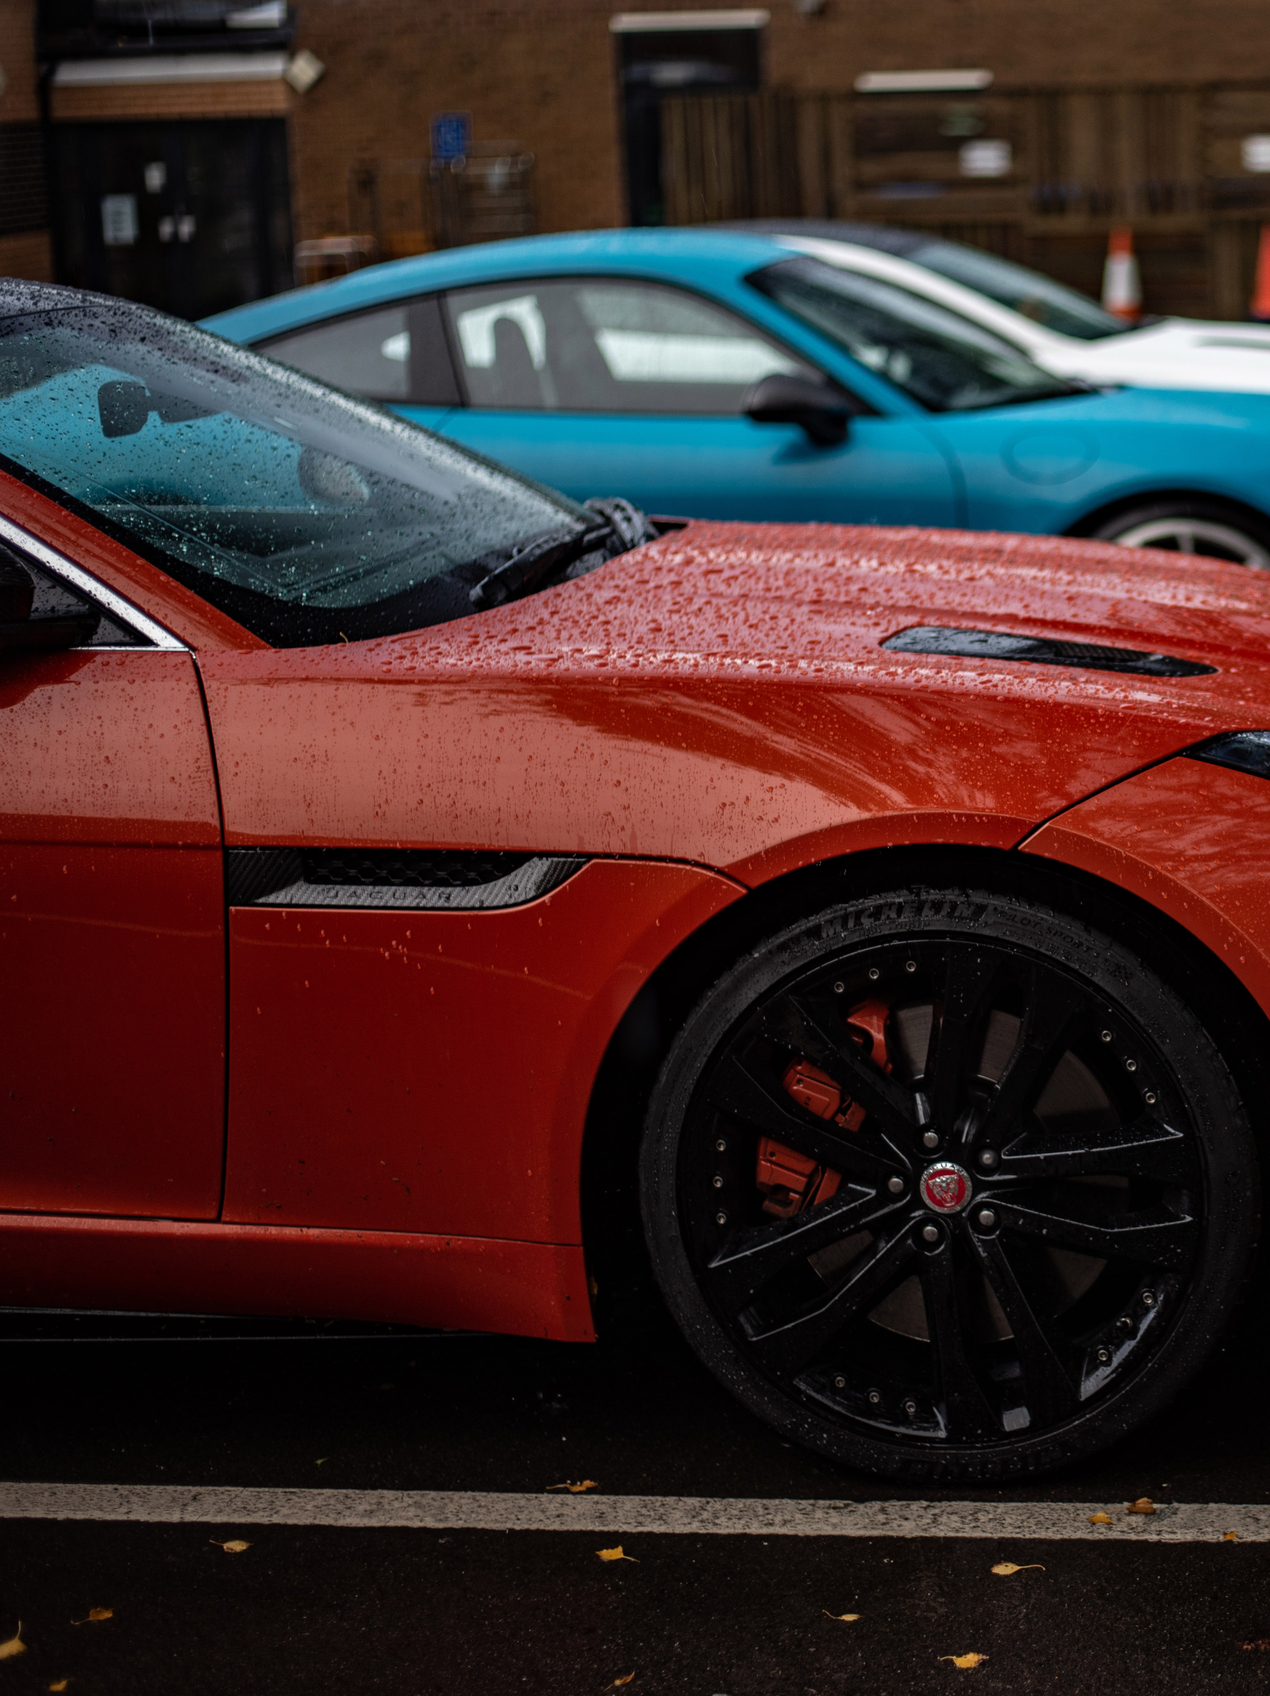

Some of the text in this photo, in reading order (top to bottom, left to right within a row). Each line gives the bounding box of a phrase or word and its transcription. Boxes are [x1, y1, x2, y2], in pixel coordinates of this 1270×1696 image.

[325, 889, 451, 903] JAGUAR
[820, 901, 977, 938] MICHELIN
[999, 909, 1042, 929] PILOT
[1046, 925, 1094, 953] SPORT
